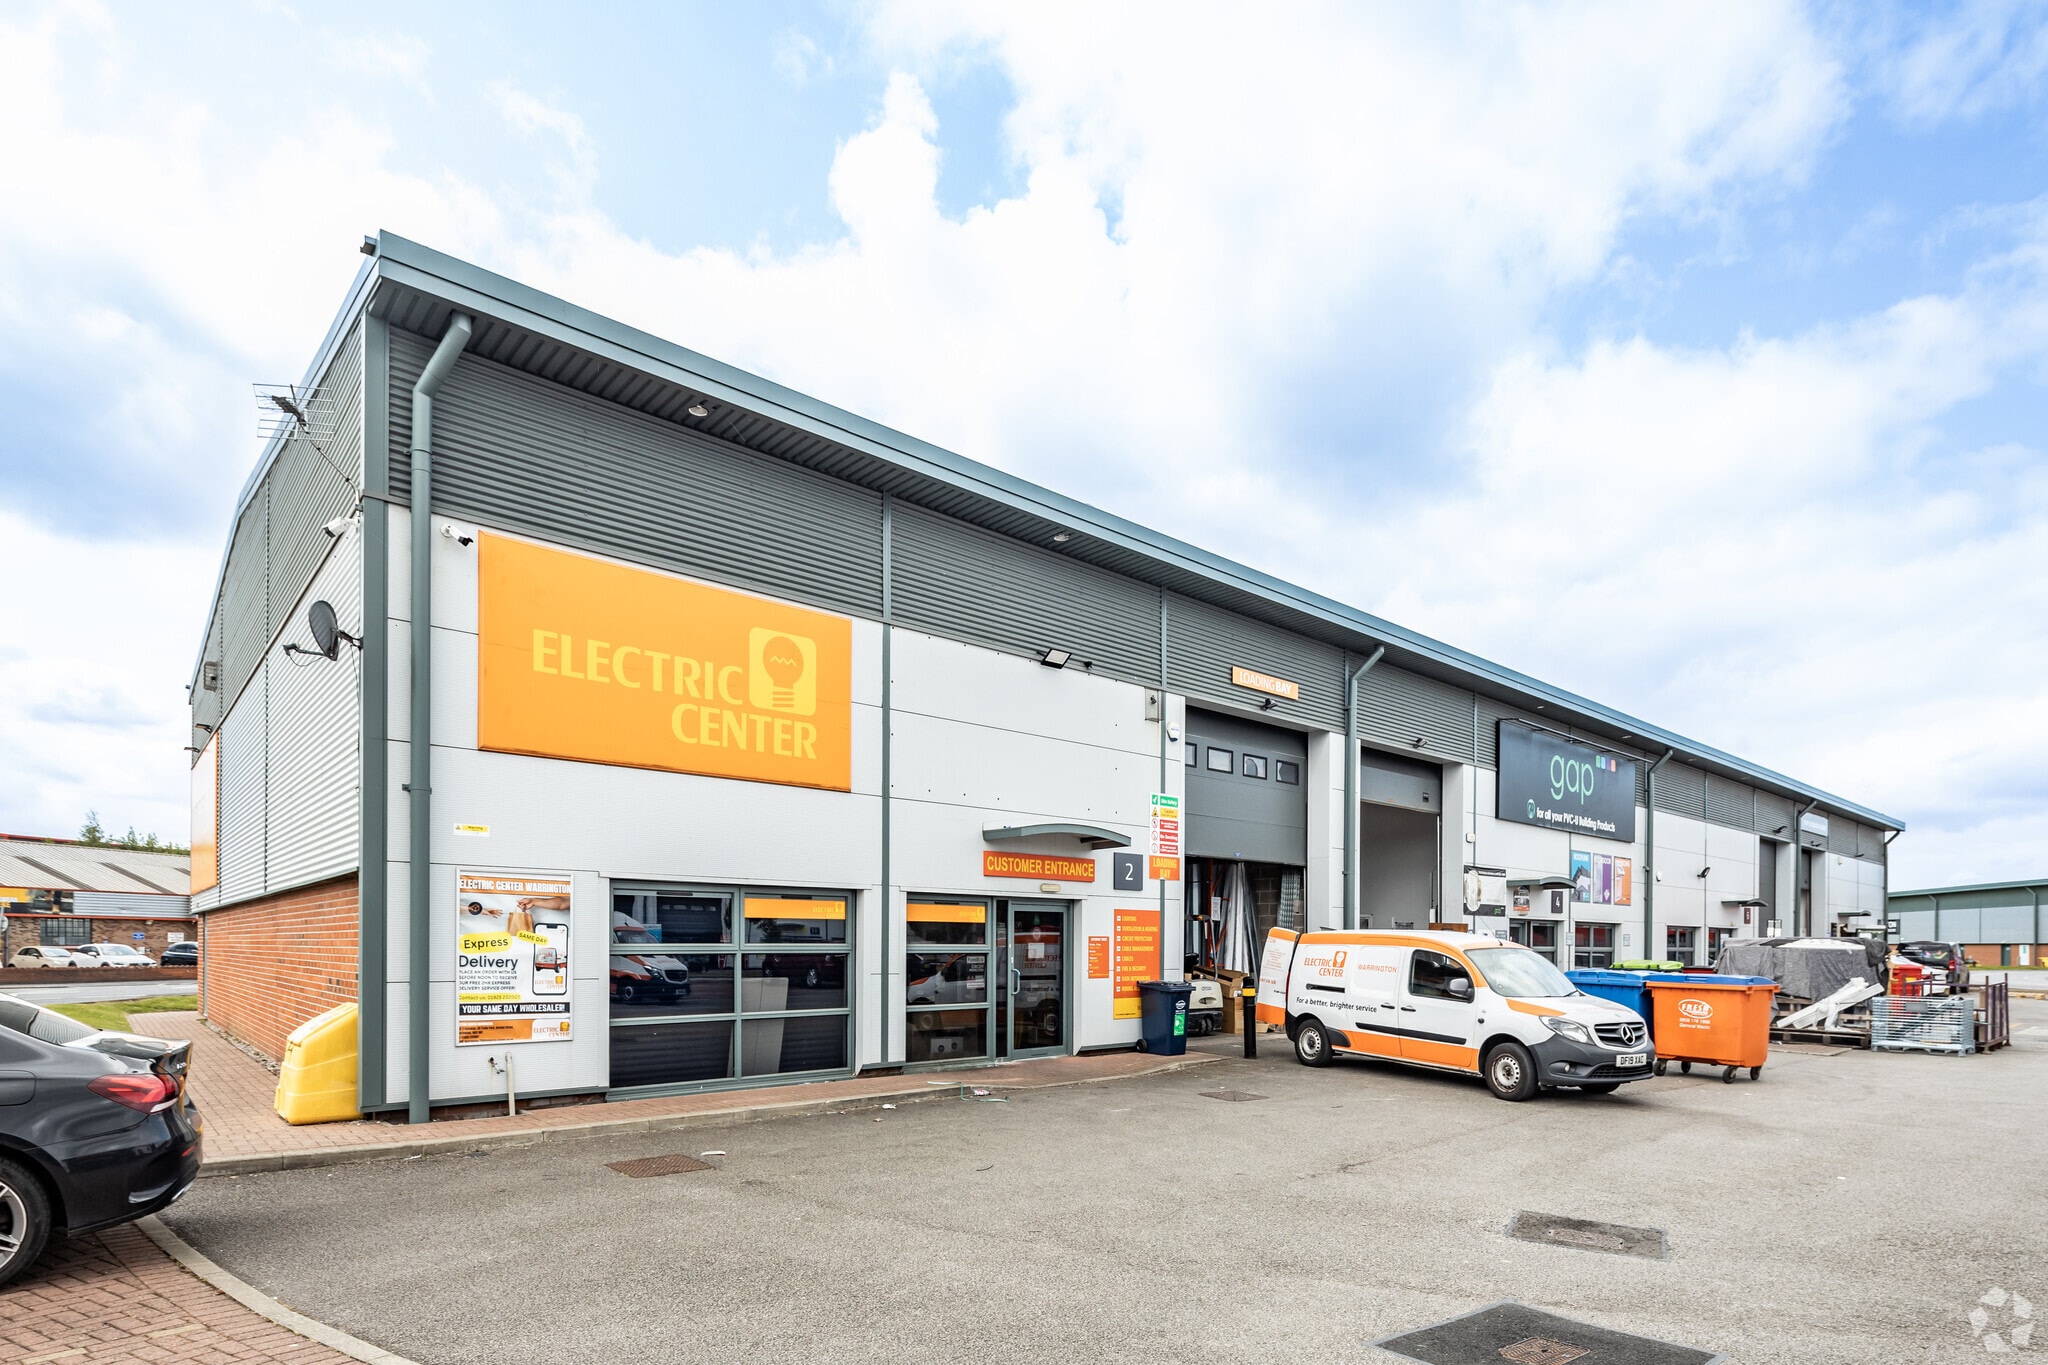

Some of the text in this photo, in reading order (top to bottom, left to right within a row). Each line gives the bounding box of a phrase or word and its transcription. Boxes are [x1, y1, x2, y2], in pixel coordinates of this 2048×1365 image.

[533, 628, 743, 706] ELECTRIC
[1239, 670, 1292, 695] LOADING BAY
[671, 703, 817, 760] CENTER
[1550, 754, 1595, 805] gap
[1536, 807, 1616, 832] for all your PVC-U Building Products
[986, 856, 1094, 877] CUSTOMER ENTRANCE
[1152, 858, 1177, 869] LOADING
[1124, 862, 1134, 881] 2
[1160, 869, 1171, 878] BAY
[460, 878, 571, 894] ELECTRIC CENTER WARRINGTON
[1556, 896, 1560, 908] 4
[464, 938, 508, 952] Express
[519, 932, 547, 944] SAME DAY
[459, 955, 518, 970] Delivery
[1304, 958, 1332, 968] ELECTRIC
[1358, 964, 1397, 973] WARRINGTON
[1319, 968, 1344, 978] CENTER
[462, 1004, 565, 1014] YOUR SAME DAY WHOLESALER!
[1309, 999, 1328, 1007] better,
[1330, 1001, 1355, 1010] brighter
[1355, 1005, 1377, 1013] service
[1682, 1003, 1709, 1012] FRESH
